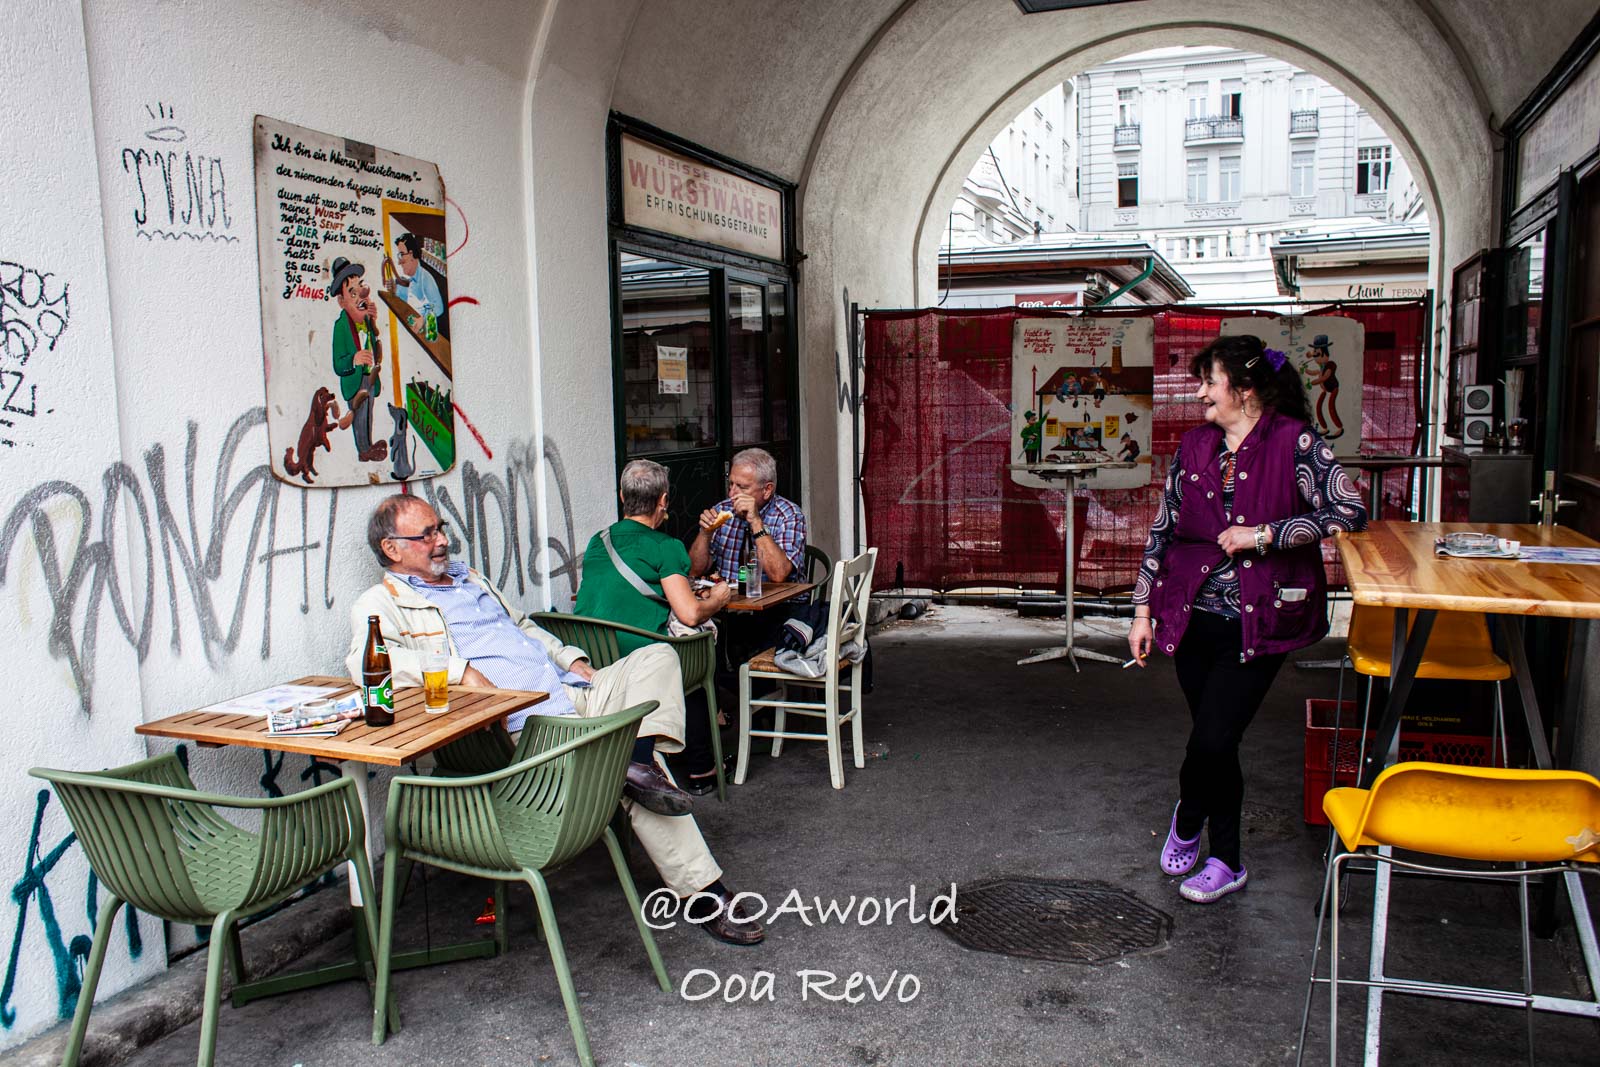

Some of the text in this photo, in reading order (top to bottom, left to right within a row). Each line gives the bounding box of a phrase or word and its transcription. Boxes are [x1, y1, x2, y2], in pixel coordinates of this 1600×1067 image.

[271, 133, 292, 153] Ich
[294, 141, 312, 158] bin
[313, 148, 328, 161] ein
[276, 163, 293, 178] der
[293, 167, 345, 189] niemanden
[386, 186, 408, 202] sehen
[656, 154, 711, 181] HEISSE
[722, 176, 758, 197] KALTE
[627, 157, 779, 229] WURSTWAREN
[314, 206, 347, 221] WURST
[295, 224, 319, 240] BIER
[319, 218, 346, 231] SENFT
[286, 235, 321, 250] dann
[283, 246, 316, 260] halt's
[285, 260, 298, 271] es
[284, 270, 302, 284] bis
[1347, 282, 1385, 300] Yumi
[410, 398, 439, 446] Bier
